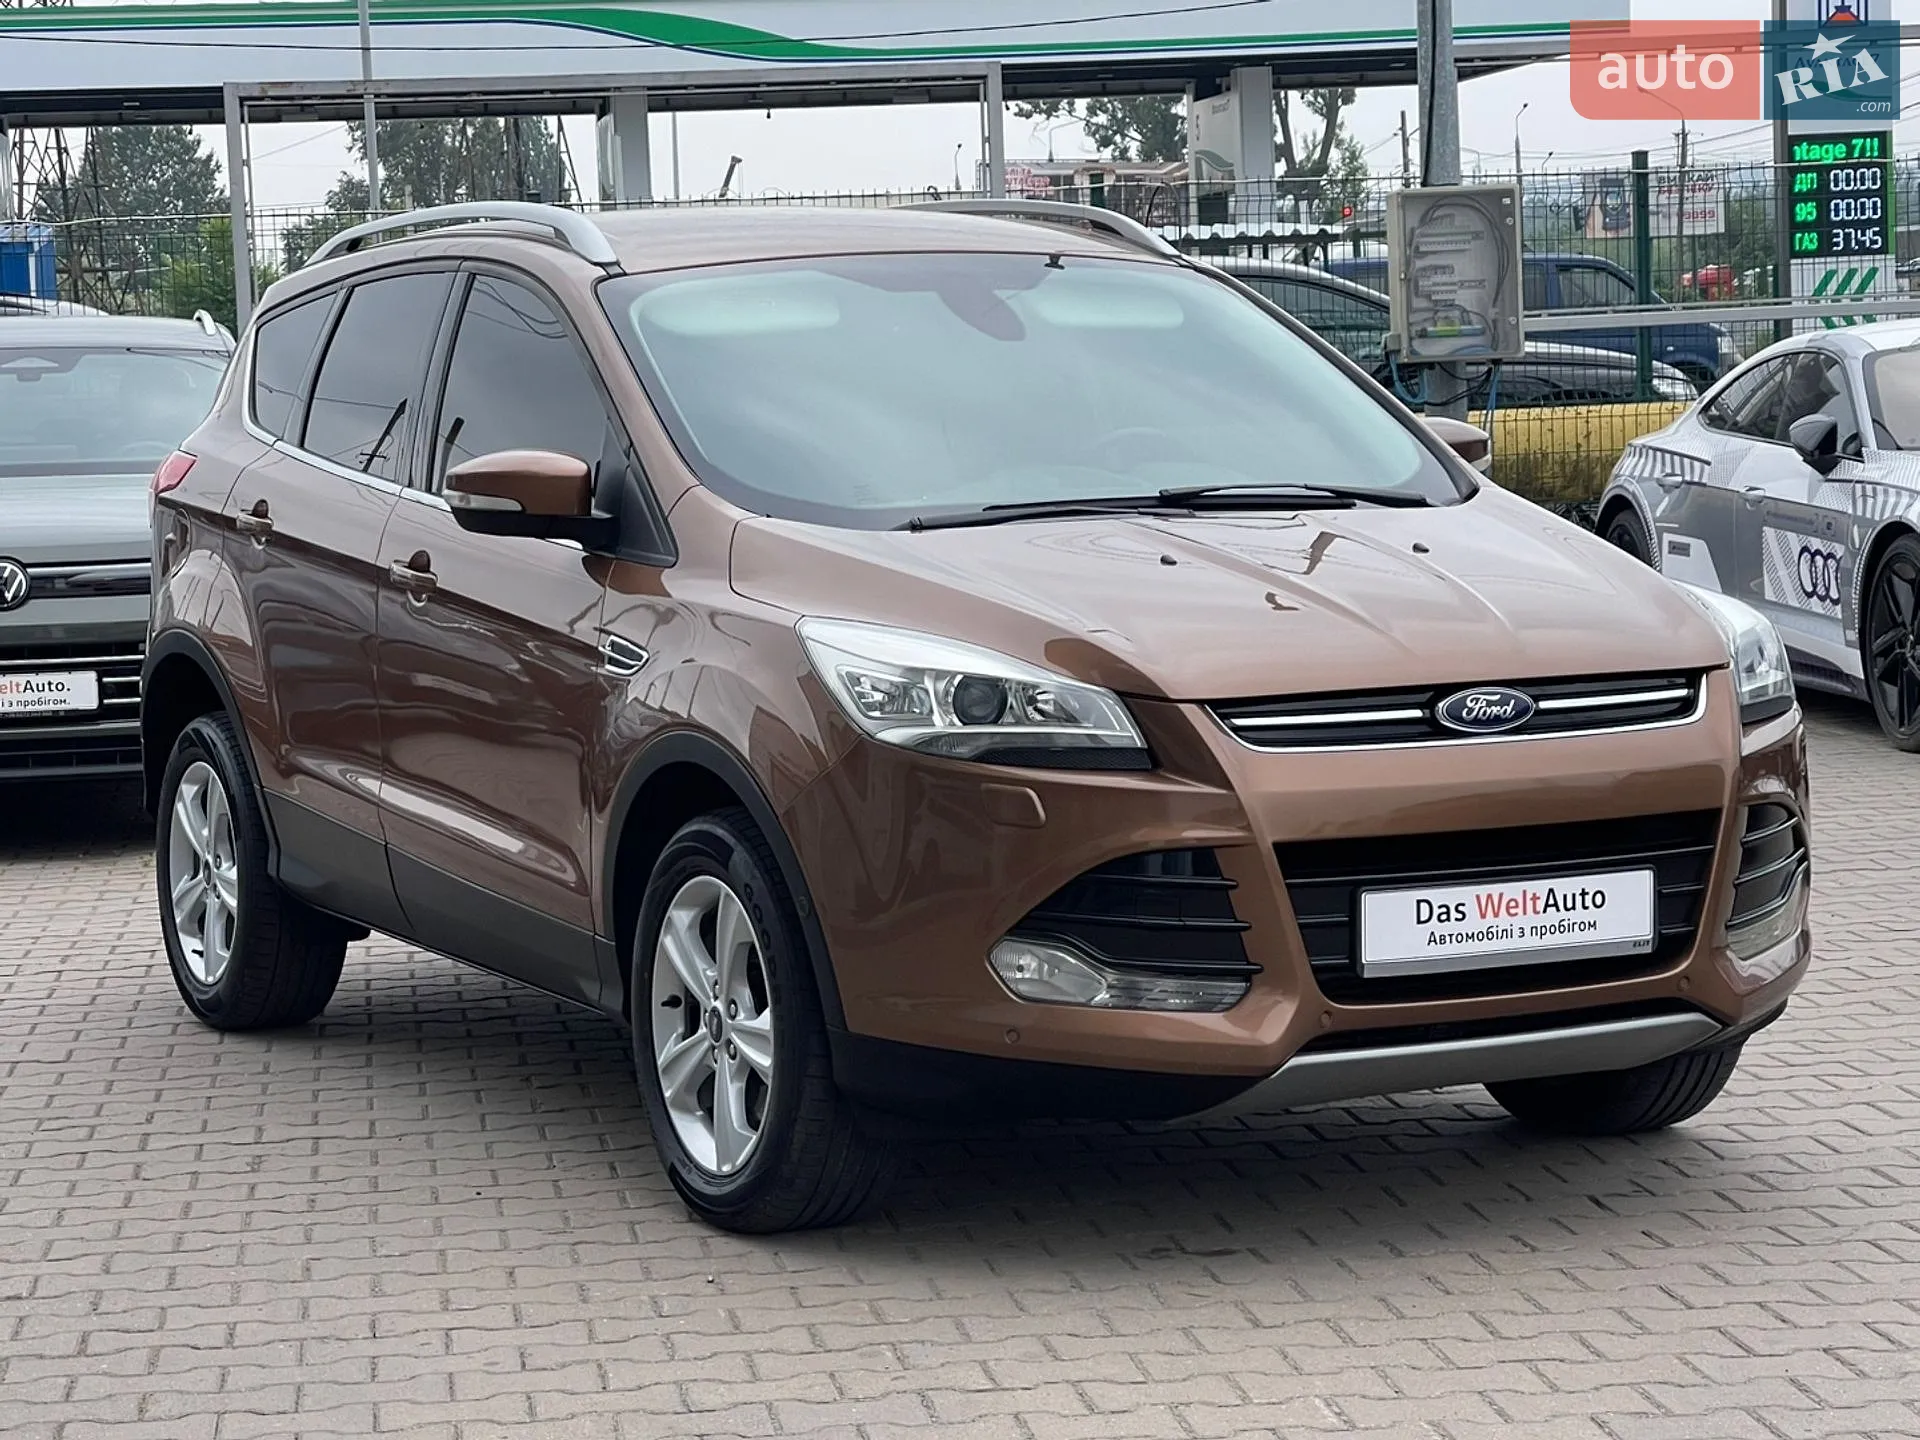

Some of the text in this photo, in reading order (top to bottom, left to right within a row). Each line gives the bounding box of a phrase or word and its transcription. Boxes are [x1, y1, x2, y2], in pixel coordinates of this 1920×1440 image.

[1794, 167, 1881, 192] ДП 00.00
[1795, 197, 1882, 222] 95 00.00
[1795, 226, 1882, 251] ГАЗ 37.45
[1462, 694, 1516, 722] Ford
[1415, 887, 1606, 925] Das WeltAuto
[1427, 918, 1597, 946] Автомобілі з пробігом
